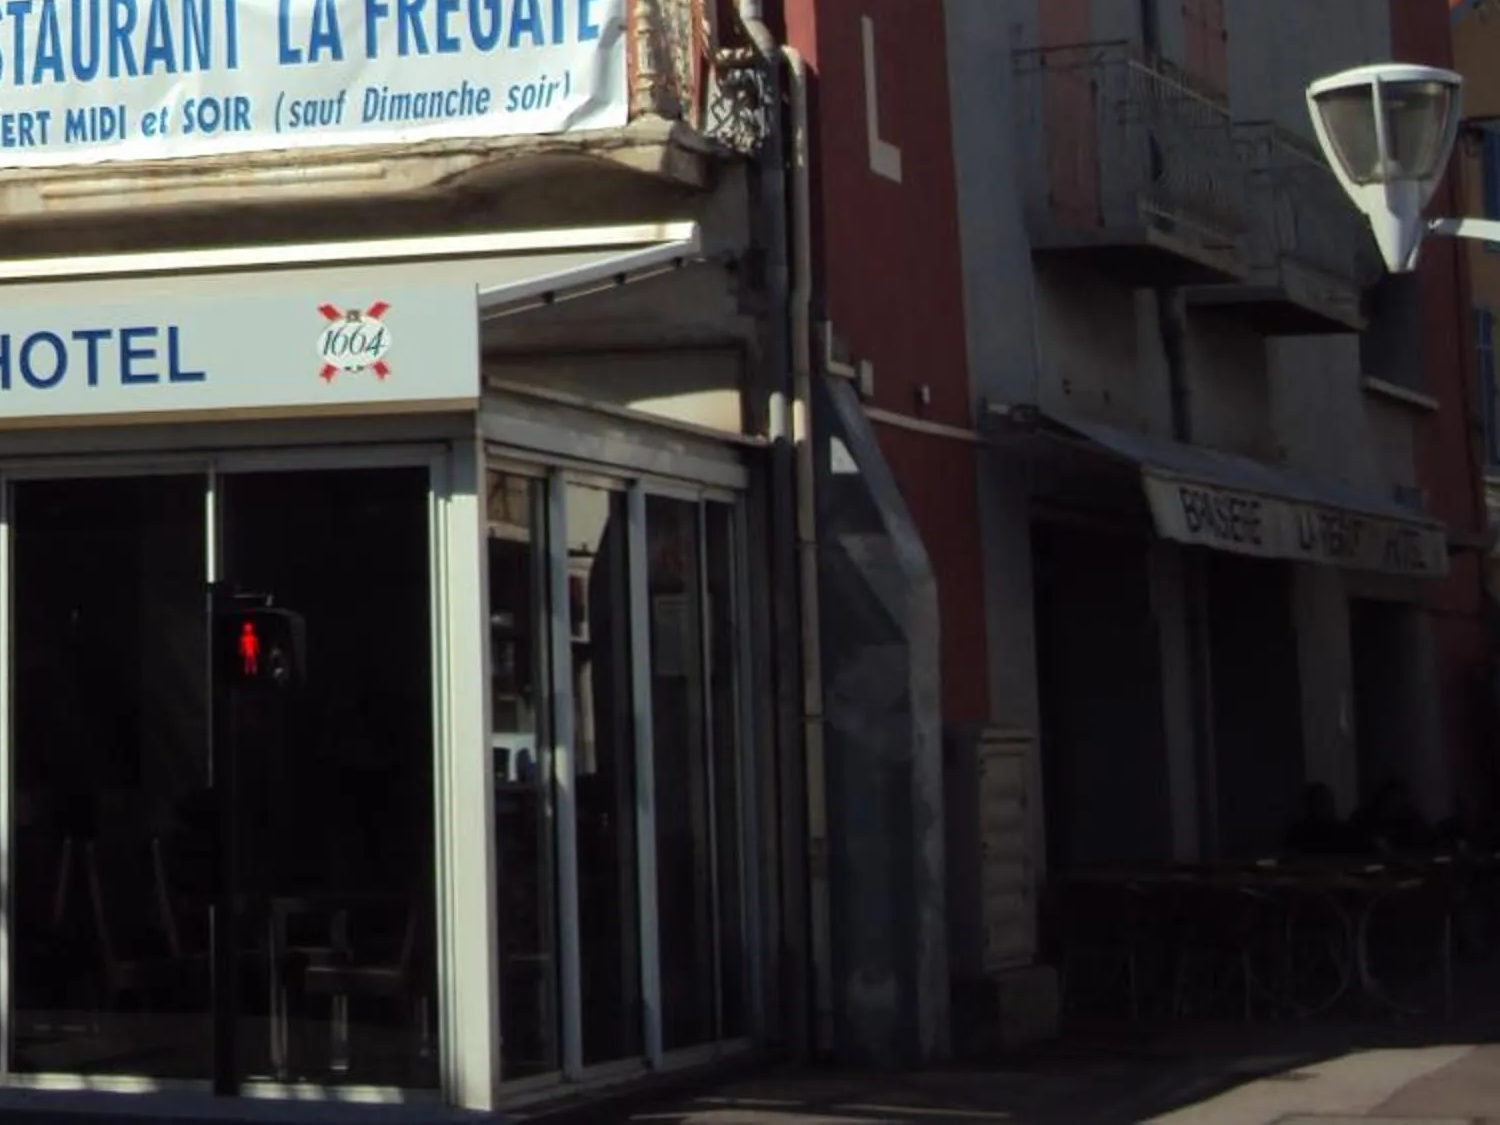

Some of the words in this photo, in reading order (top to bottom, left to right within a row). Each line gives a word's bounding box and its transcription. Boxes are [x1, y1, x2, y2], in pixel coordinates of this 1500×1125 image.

[63, 103, 128, 143] MIDI
[139, 106, 171, 139] et
[181, 93, 252, 136] SOIR
[273, 86, 346, 134] (sauf
[360, 83, 492, 124] Dimanche
[506, 72, 572, 113] soir)
[323, 326, 385, 357] 1664
